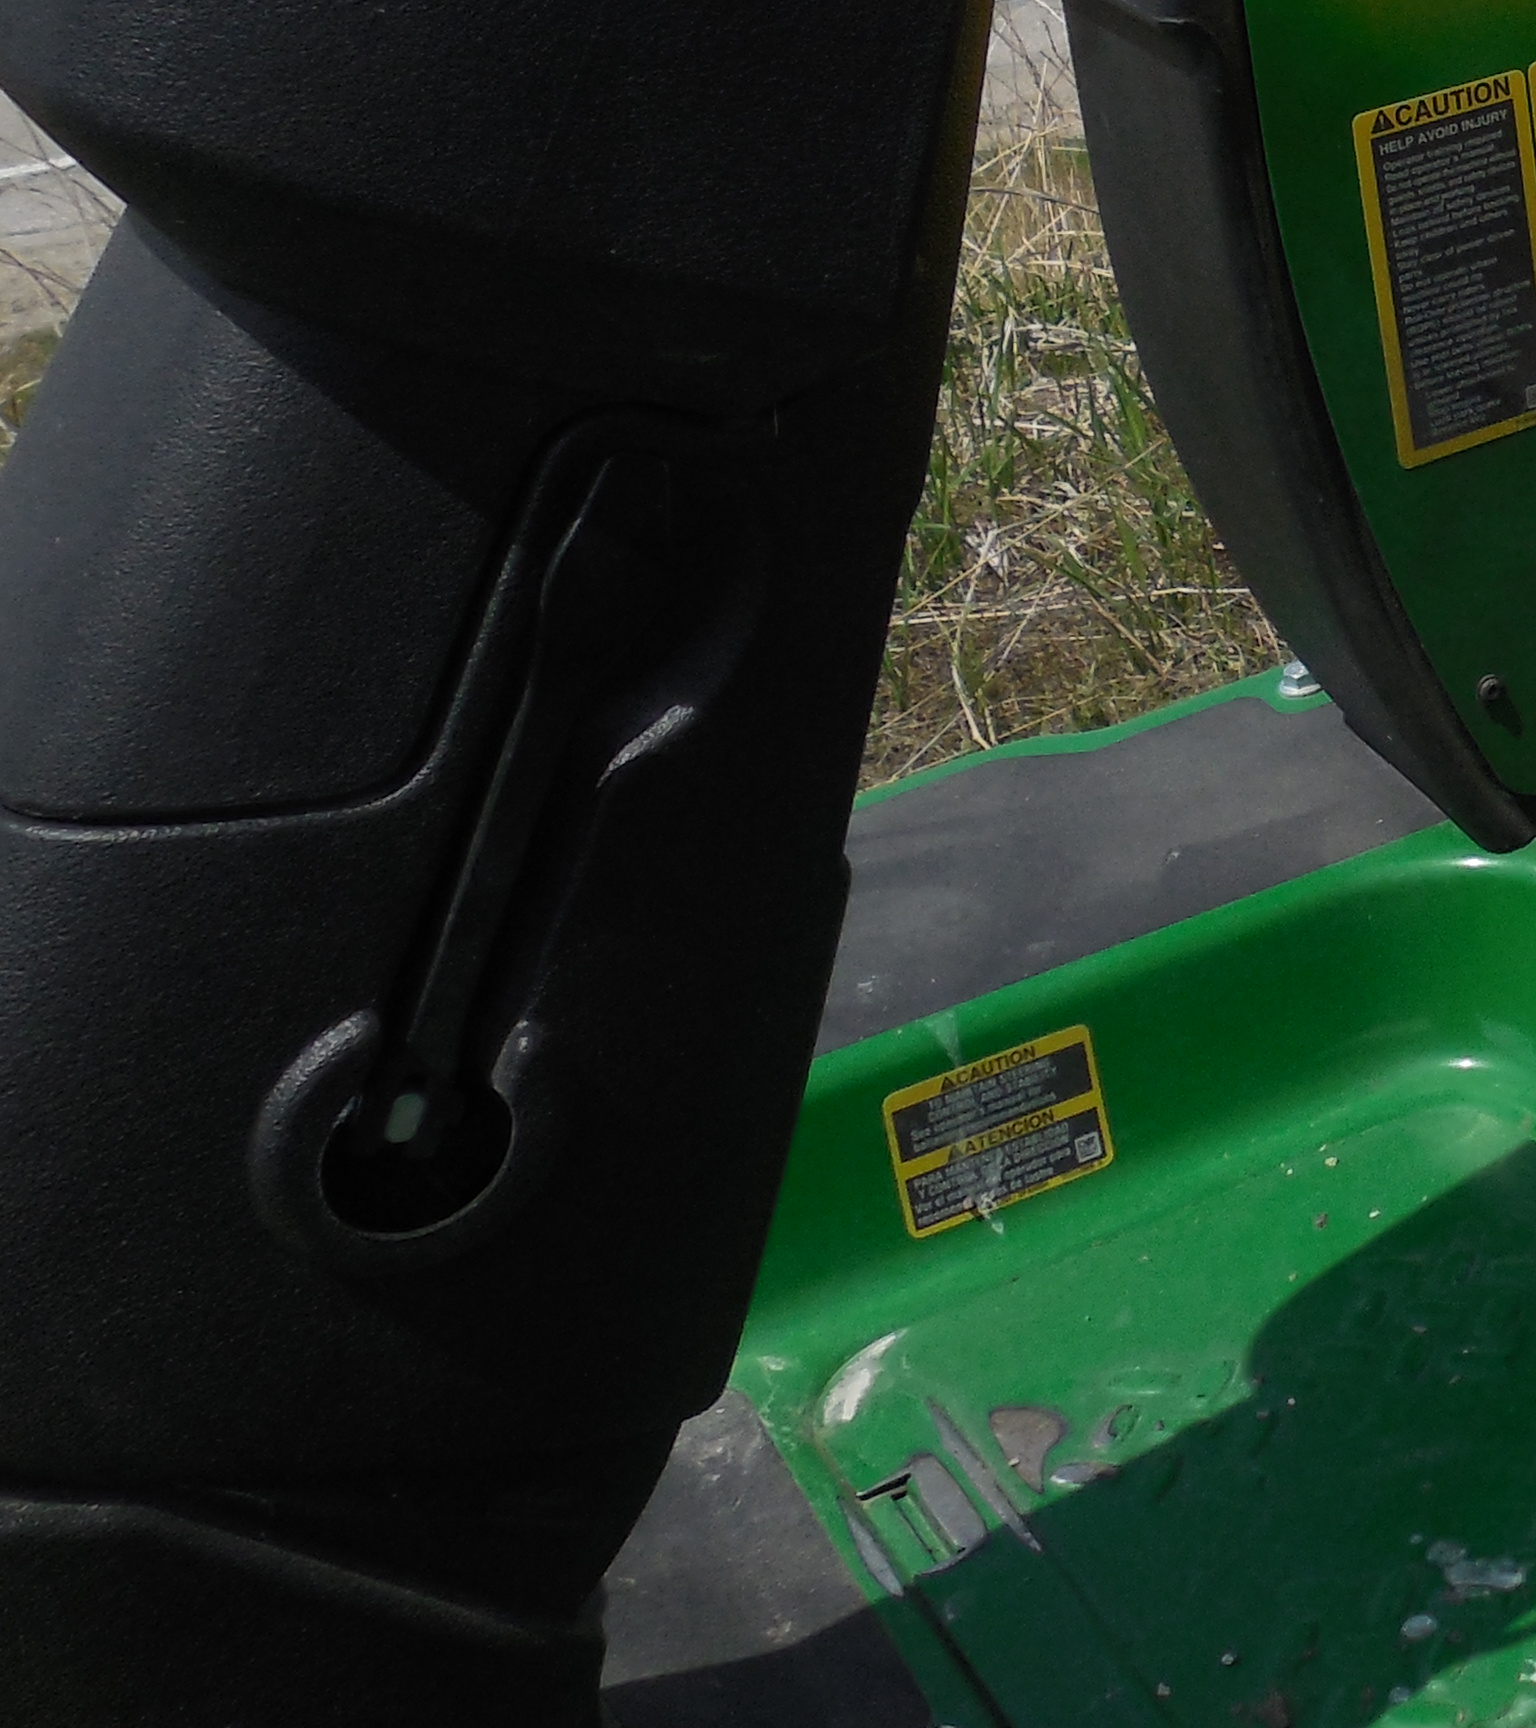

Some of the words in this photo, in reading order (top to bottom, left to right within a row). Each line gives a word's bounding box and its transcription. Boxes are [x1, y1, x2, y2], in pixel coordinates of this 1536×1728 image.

[1394, 74, 1511, 128] CAUTION
[1378, 135, 1414, 156] HELP
[1417, 122, 1459, 145] AVOID
[1460, 107, 1508, 132] INJURY
[954, 1044, 1037, 1086] CAUTION
[963, 1108, 1054, 1154] ATENCION
